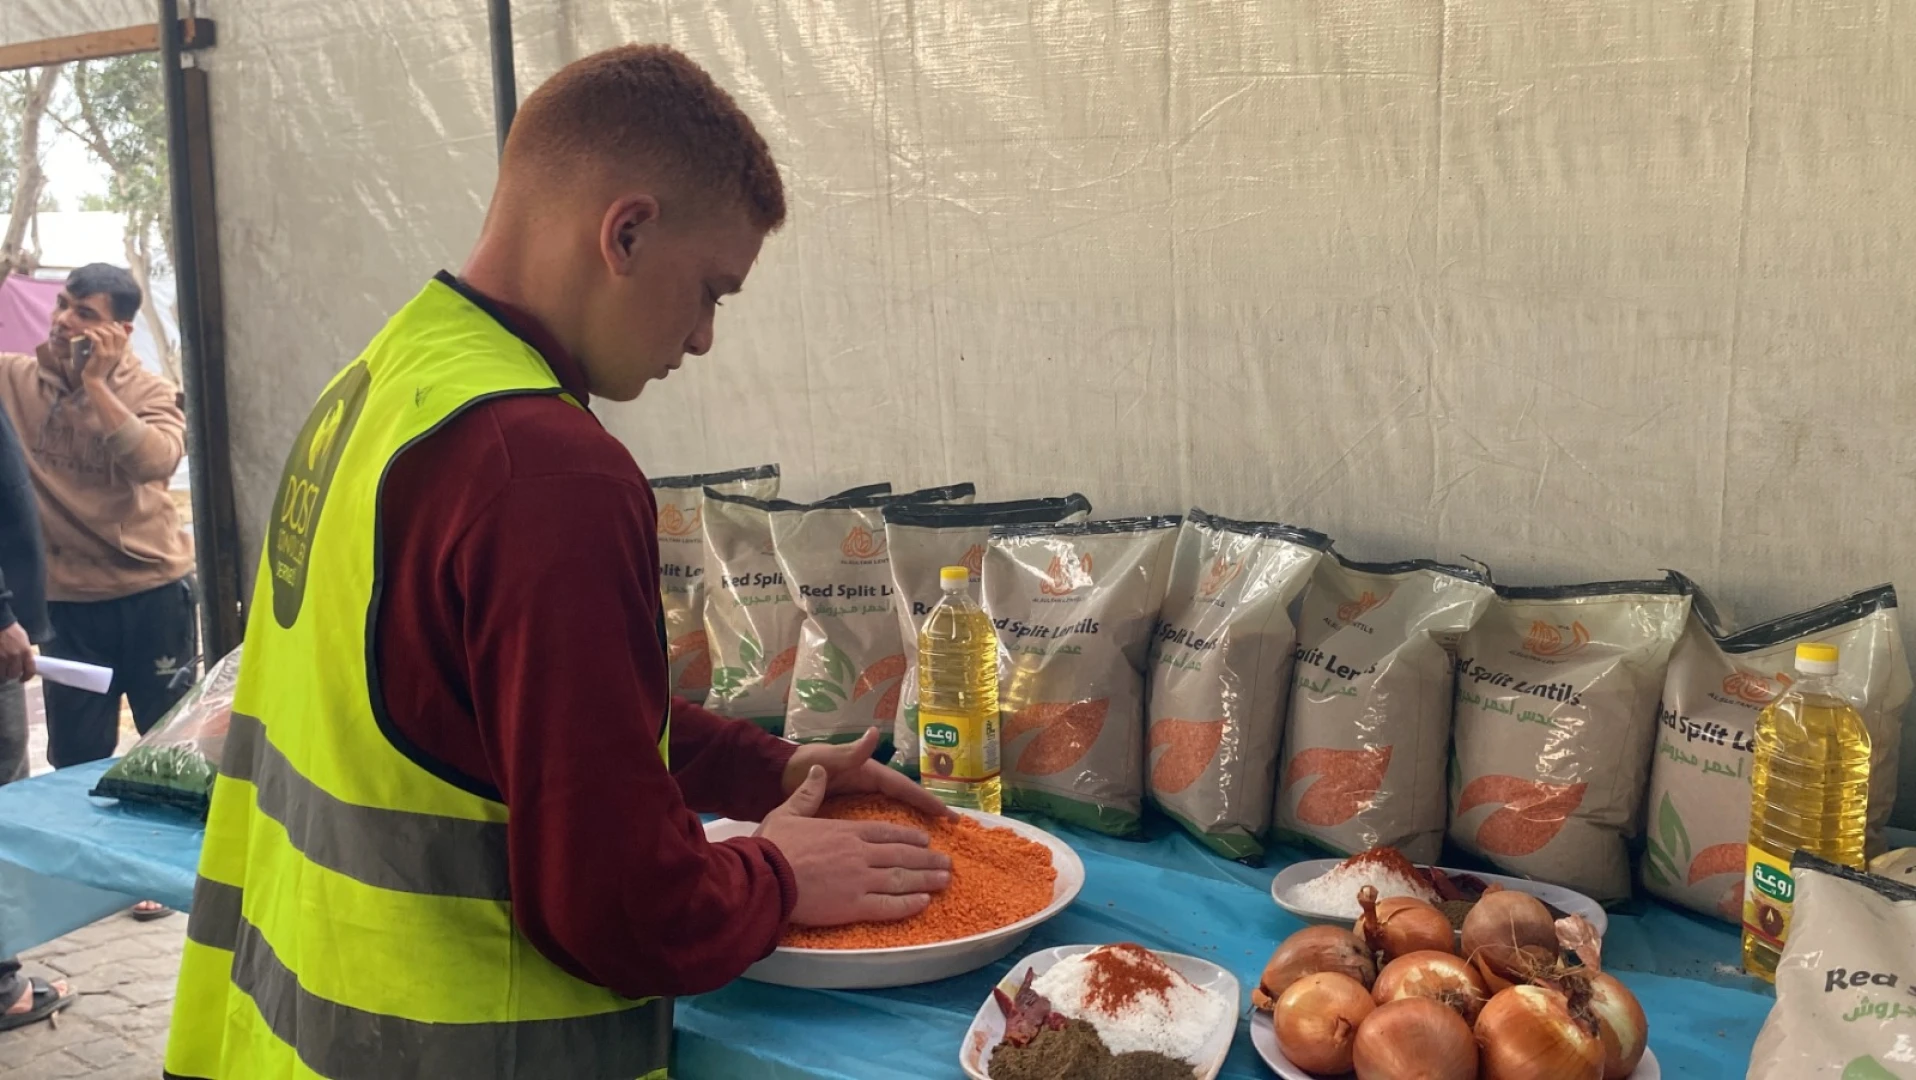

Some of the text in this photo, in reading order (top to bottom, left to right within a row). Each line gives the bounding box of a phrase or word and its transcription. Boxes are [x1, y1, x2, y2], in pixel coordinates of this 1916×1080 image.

[753, 573, 787, 588] Spli
[799, 584, 833, 598] Red
[837, 584, 876, 599] Split
[1008, 621, 1050, 638] Split
[1159, 623, 1188, 644] Split
[1468, 665, 1514, 687] Split
[1512, 682, 1583, 706] Lentils
[926, 726, 957, 744] روعة
[1679, 716, 1728, 743] Split
[1754, 865, 1793, 898] روعة
[1842, 996, 1916, 1022] جروش
